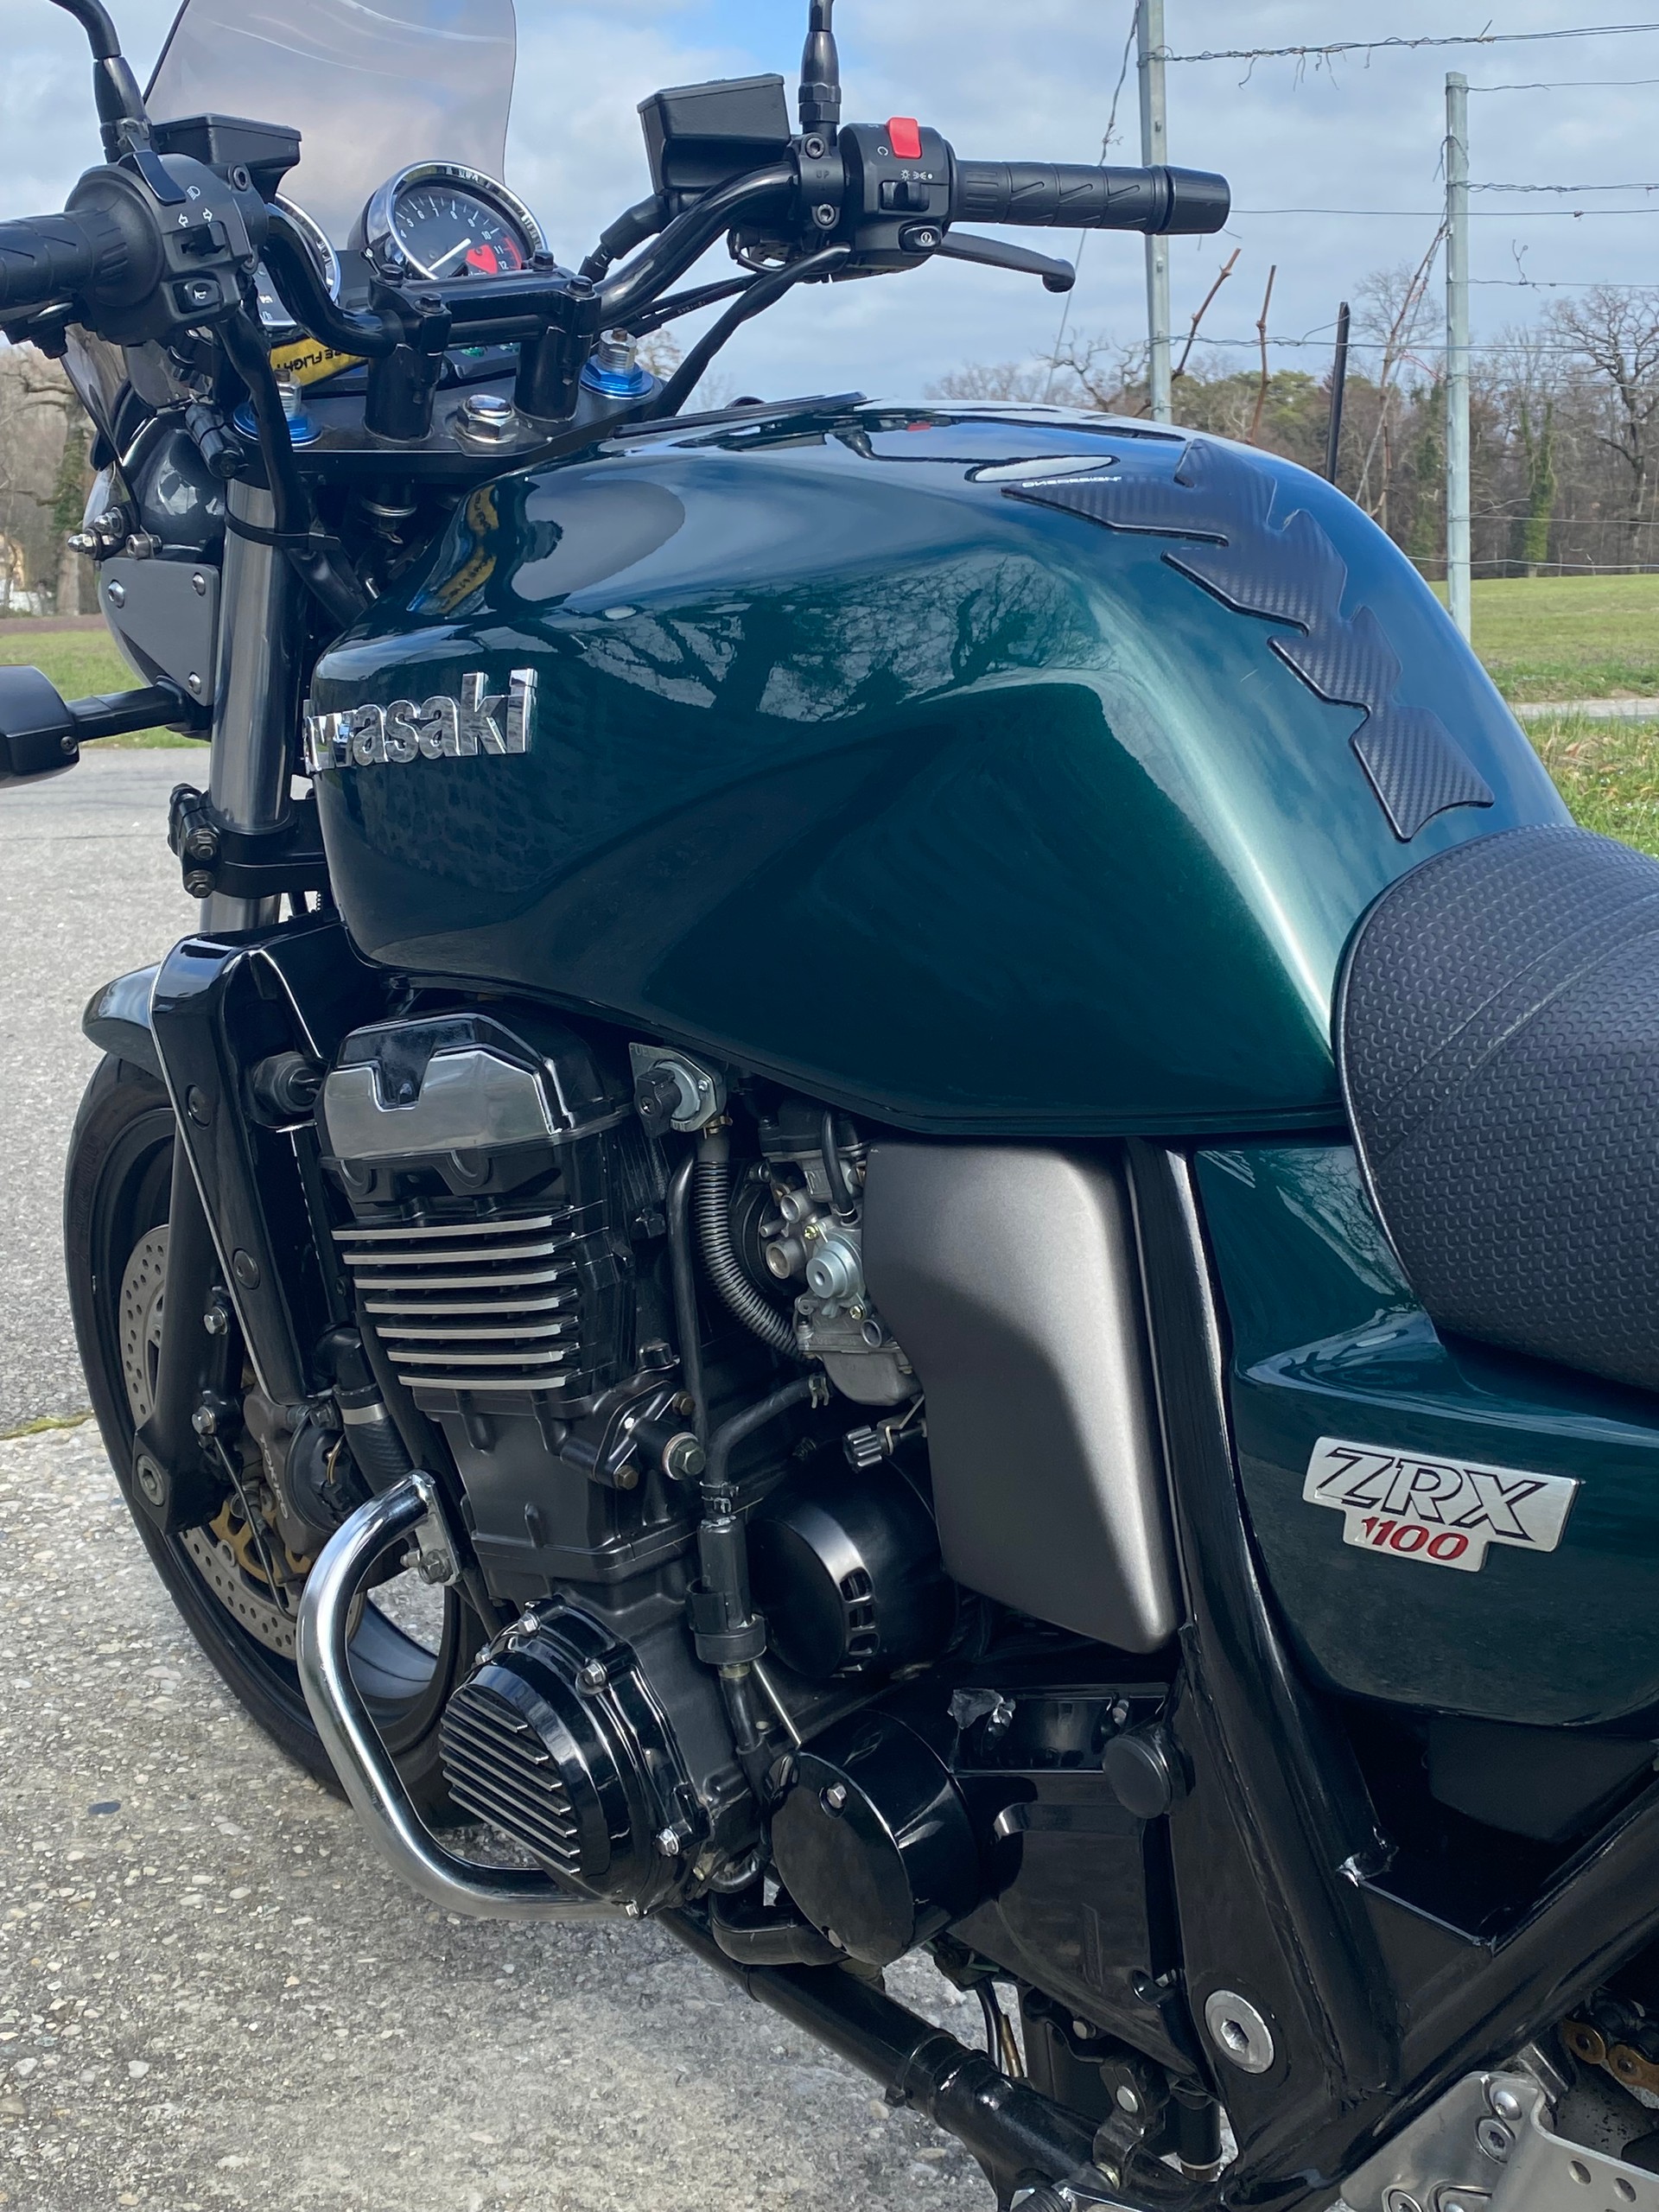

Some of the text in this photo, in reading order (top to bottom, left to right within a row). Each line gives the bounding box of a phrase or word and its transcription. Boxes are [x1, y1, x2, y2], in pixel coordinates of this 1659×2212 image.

[416, 210, 425, 219] 6
[432, 207, 440, 218] 7
[449, 210, 458, 220] 8
[406, 218, 415, 228] 5
[467, 218, 476, 227] 9
[400, 229, 407, 238] 4
[481, 230, 492, 240] 10
[493, 245, 505, 254] 11
[498, 260, 510, 270] 12
[276, 351, 322, 372] FLIGH
[260, 1433, 288, 1519] TOKICO
[1315, 1446, 1548, 1542] ZRX
[1356, 1516, 1470, 1560] 1100
